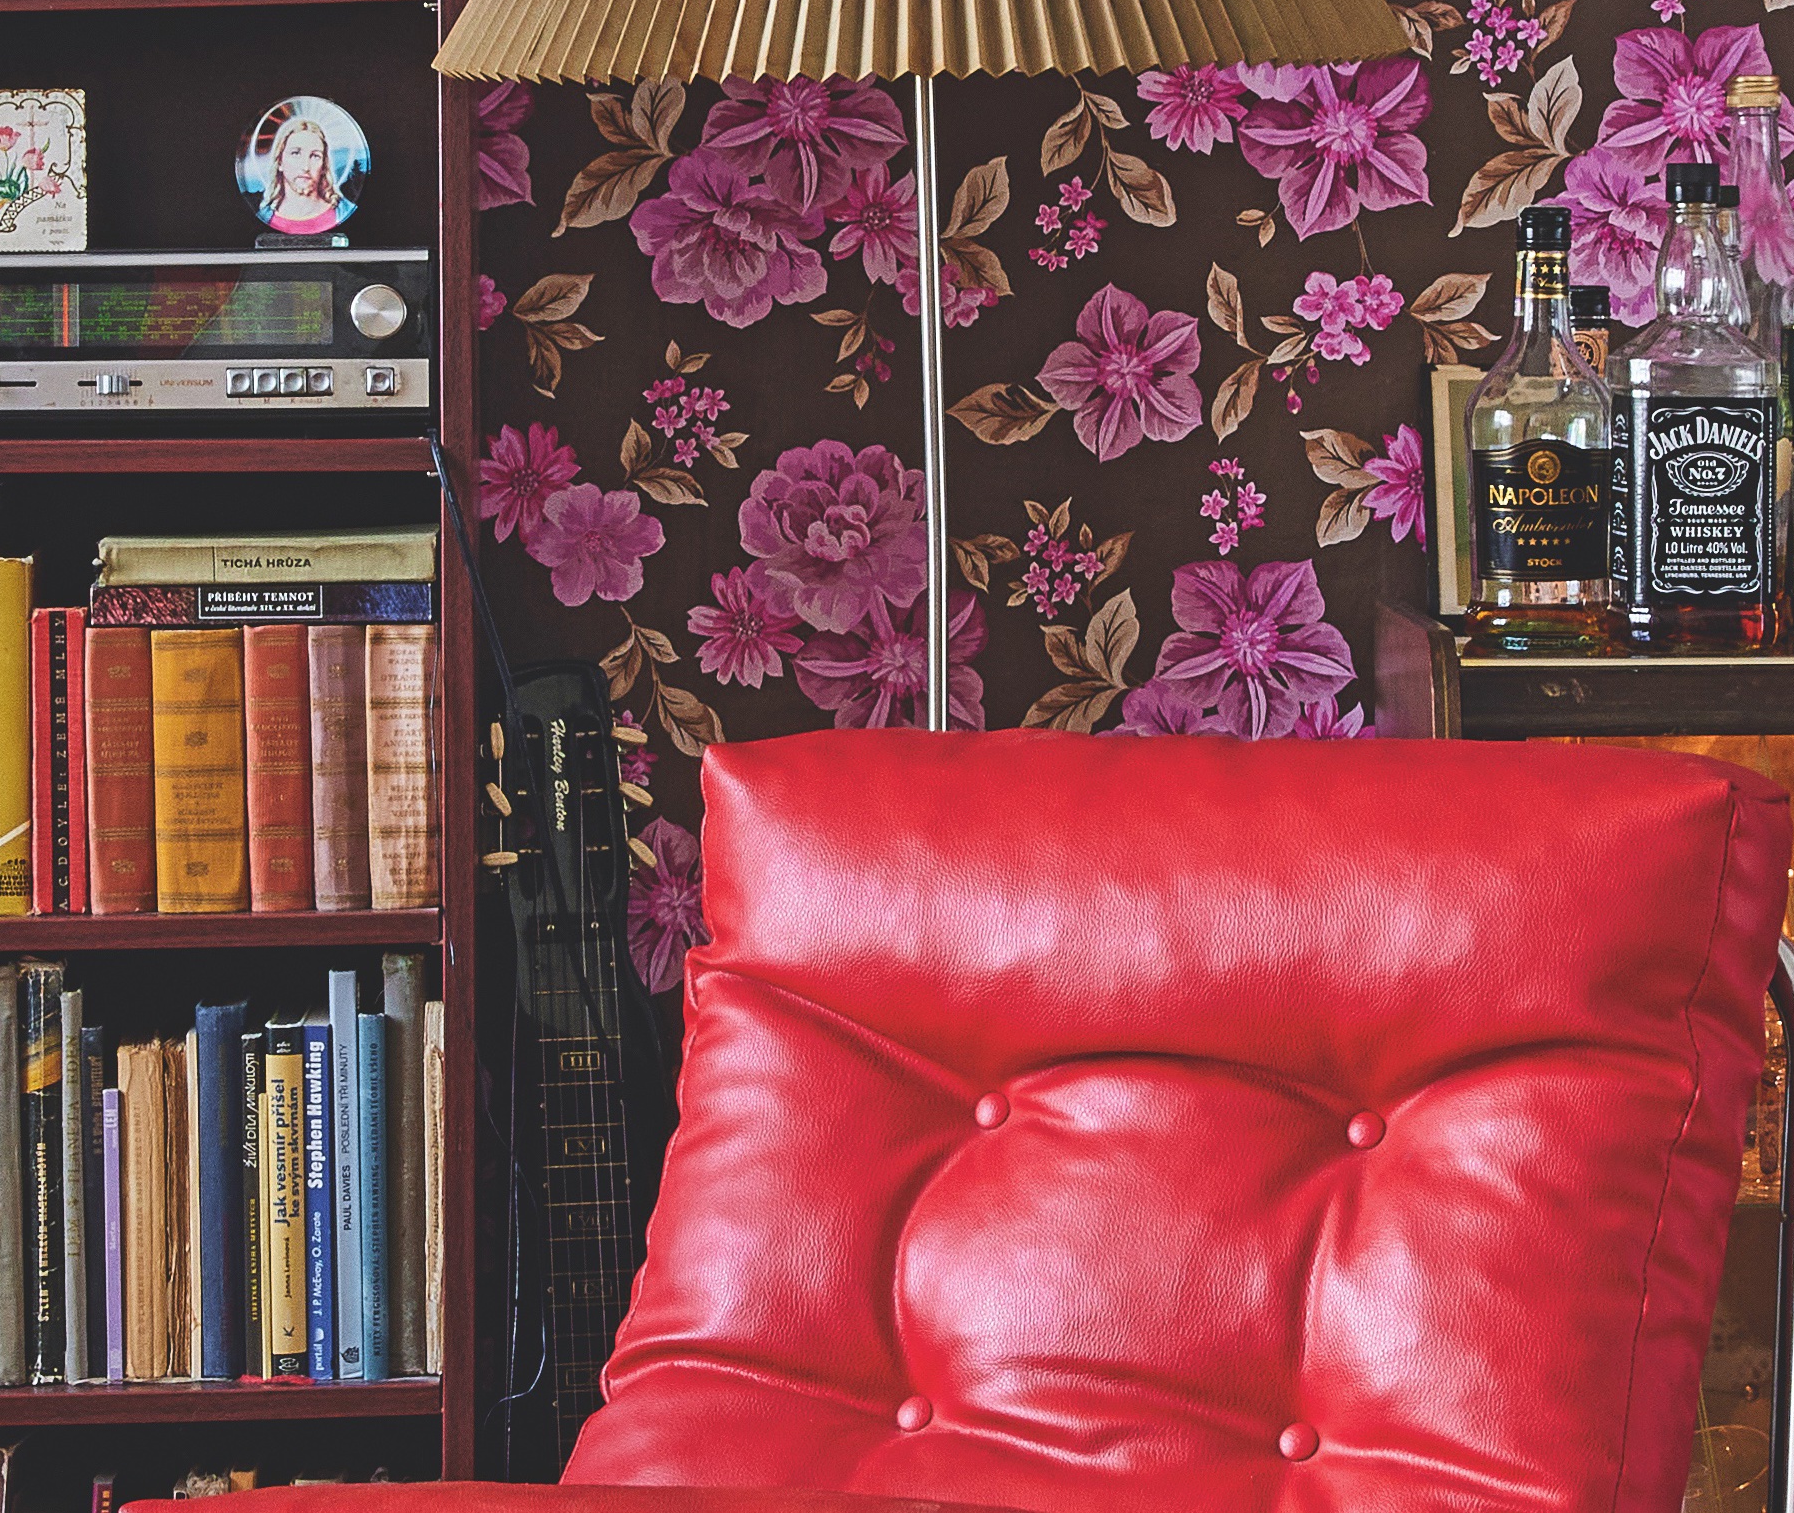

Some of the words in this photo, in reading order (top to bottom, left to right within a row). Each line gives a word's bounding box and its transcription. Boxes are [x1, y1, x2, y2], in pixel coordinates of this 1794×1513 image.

[1649, 425, 1693, 459] JACK
[1489, 485, 1599, 506] NAPOLEON
[1669, 499, 1745, 516] Tennessee
[1670, 526, 1743, 538] WHISKEY
[1680, 542, 1703, 554] Litre
[1705, 542, 1728, 554] 40%
[223, 559, 261, 568] TICHÁ
[268, 558, 312, 568] HRŮZA
[1527, 558, 1563, 567] STOCK
[305, 1042, 325, 1115] Hawking
[307, 1119, 326, 1188] Stephen
